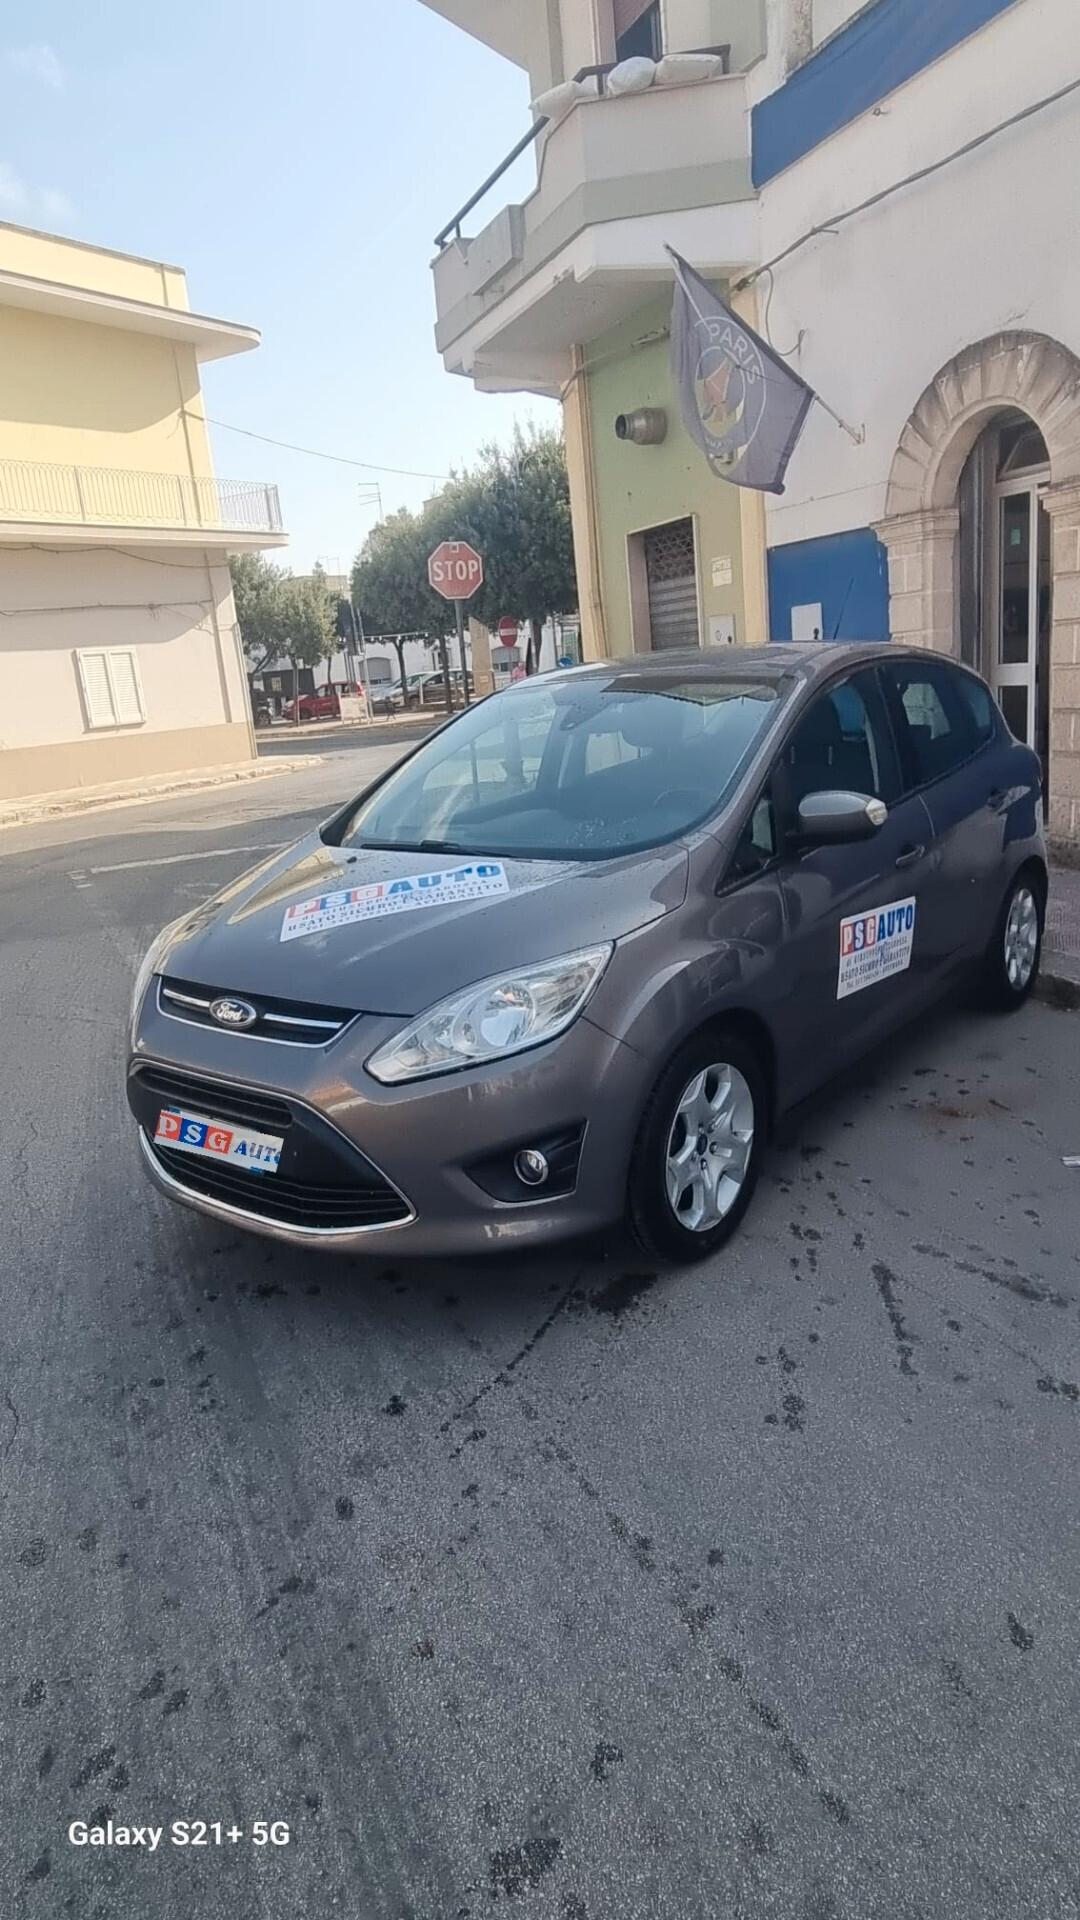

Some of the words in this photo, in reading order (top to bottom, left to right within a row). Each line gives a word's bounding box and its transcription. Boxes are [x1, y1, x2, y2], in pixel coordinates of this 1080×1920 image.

[708, 322, 761, 385] PARIS
[432, 559, 479, 581] STOP
[216, 1001, 244, 1022] Ford
